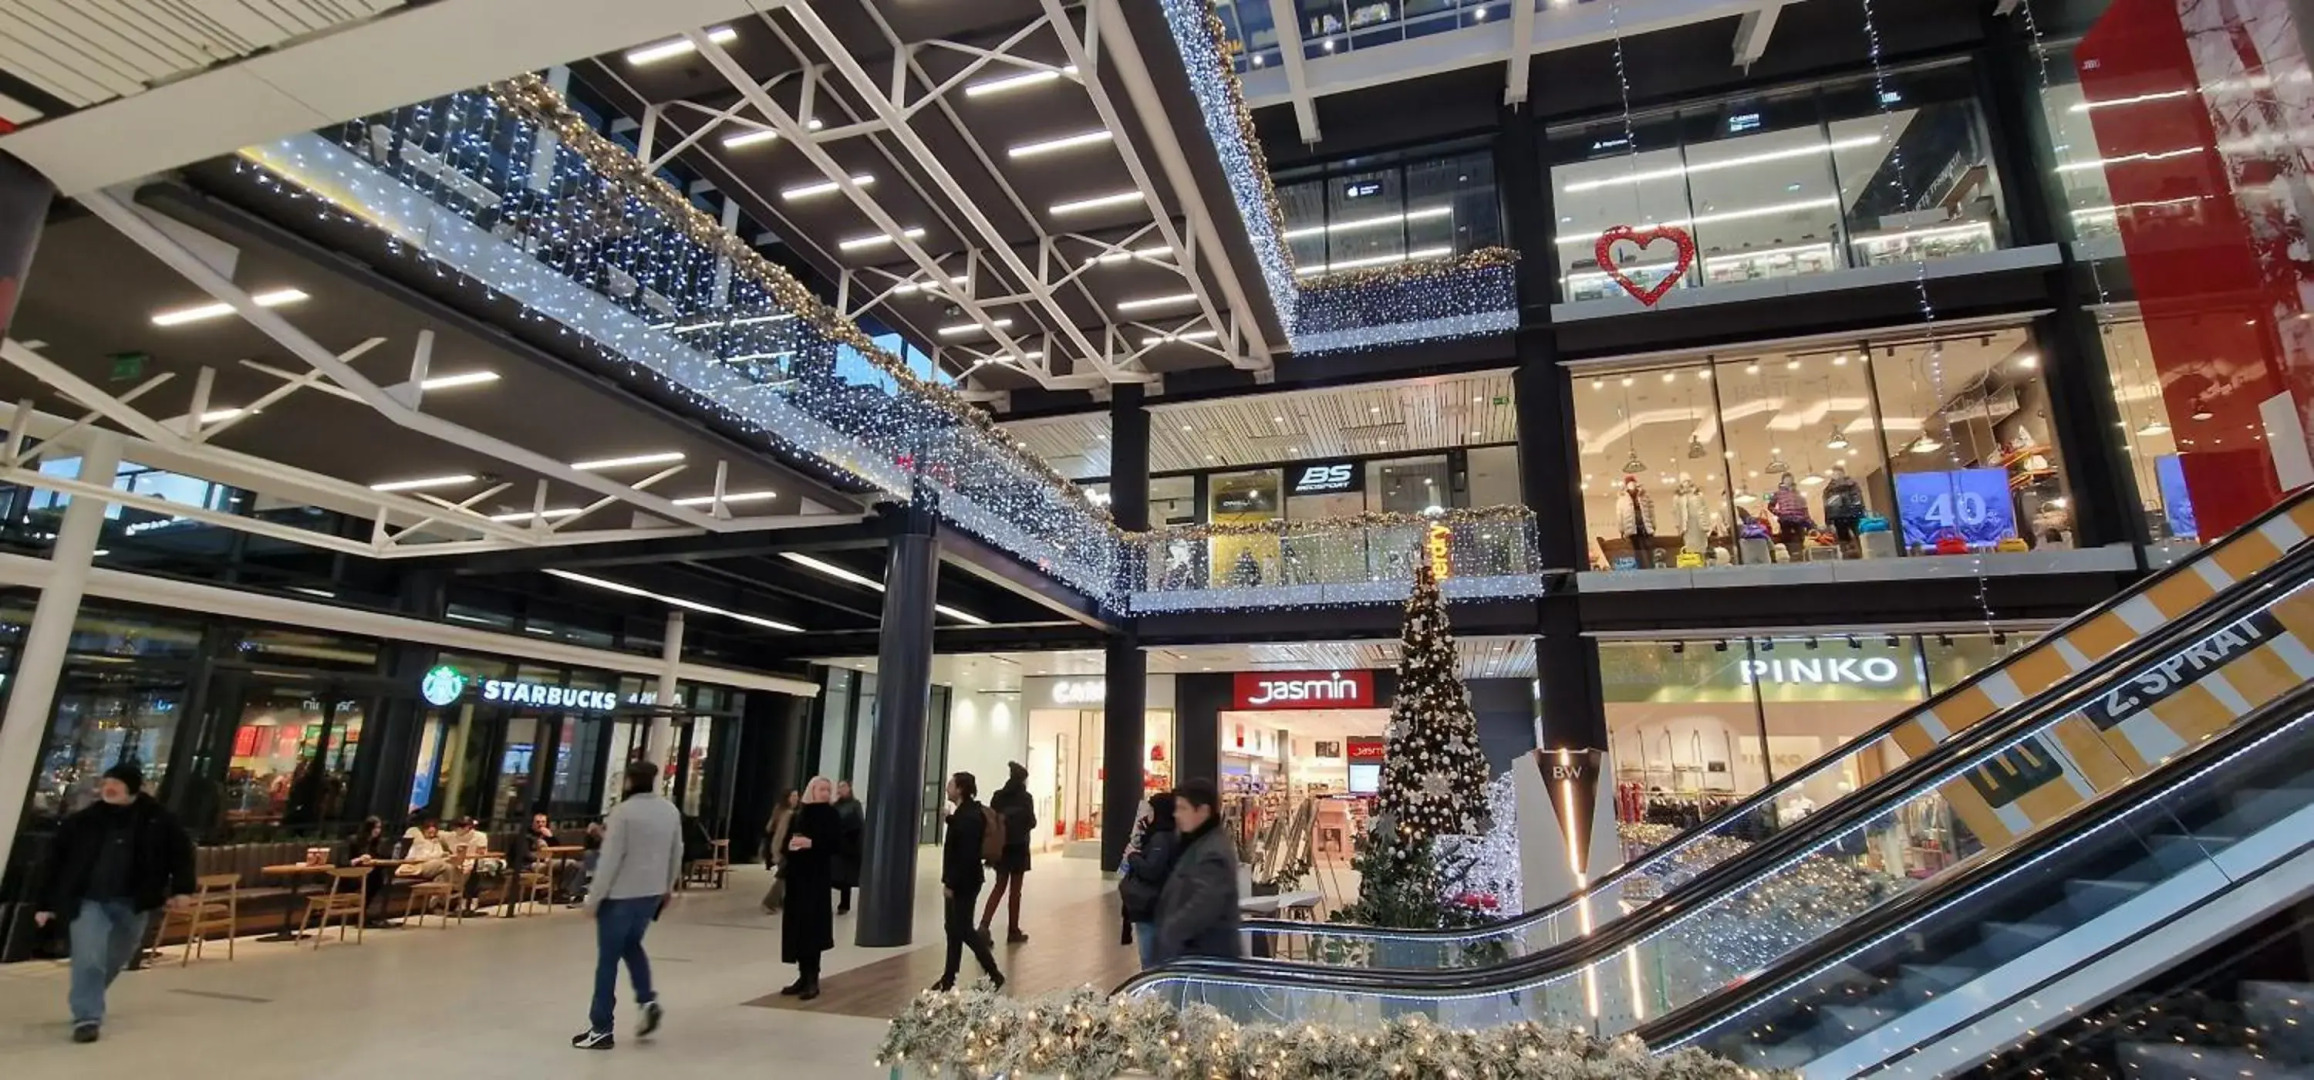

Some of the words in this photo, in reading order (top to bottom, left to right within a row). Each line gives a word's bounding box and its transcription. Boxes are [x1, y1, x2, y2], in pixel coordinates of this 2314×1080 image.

[1299, 464, 1352, 484] BS
[1911, 494, 1928, 503] do
[1740, 657, 1898, 683] PINKO
[484, 680, 617, 710] STARBUCKS
[1552, 765, 1583, 779] BW
